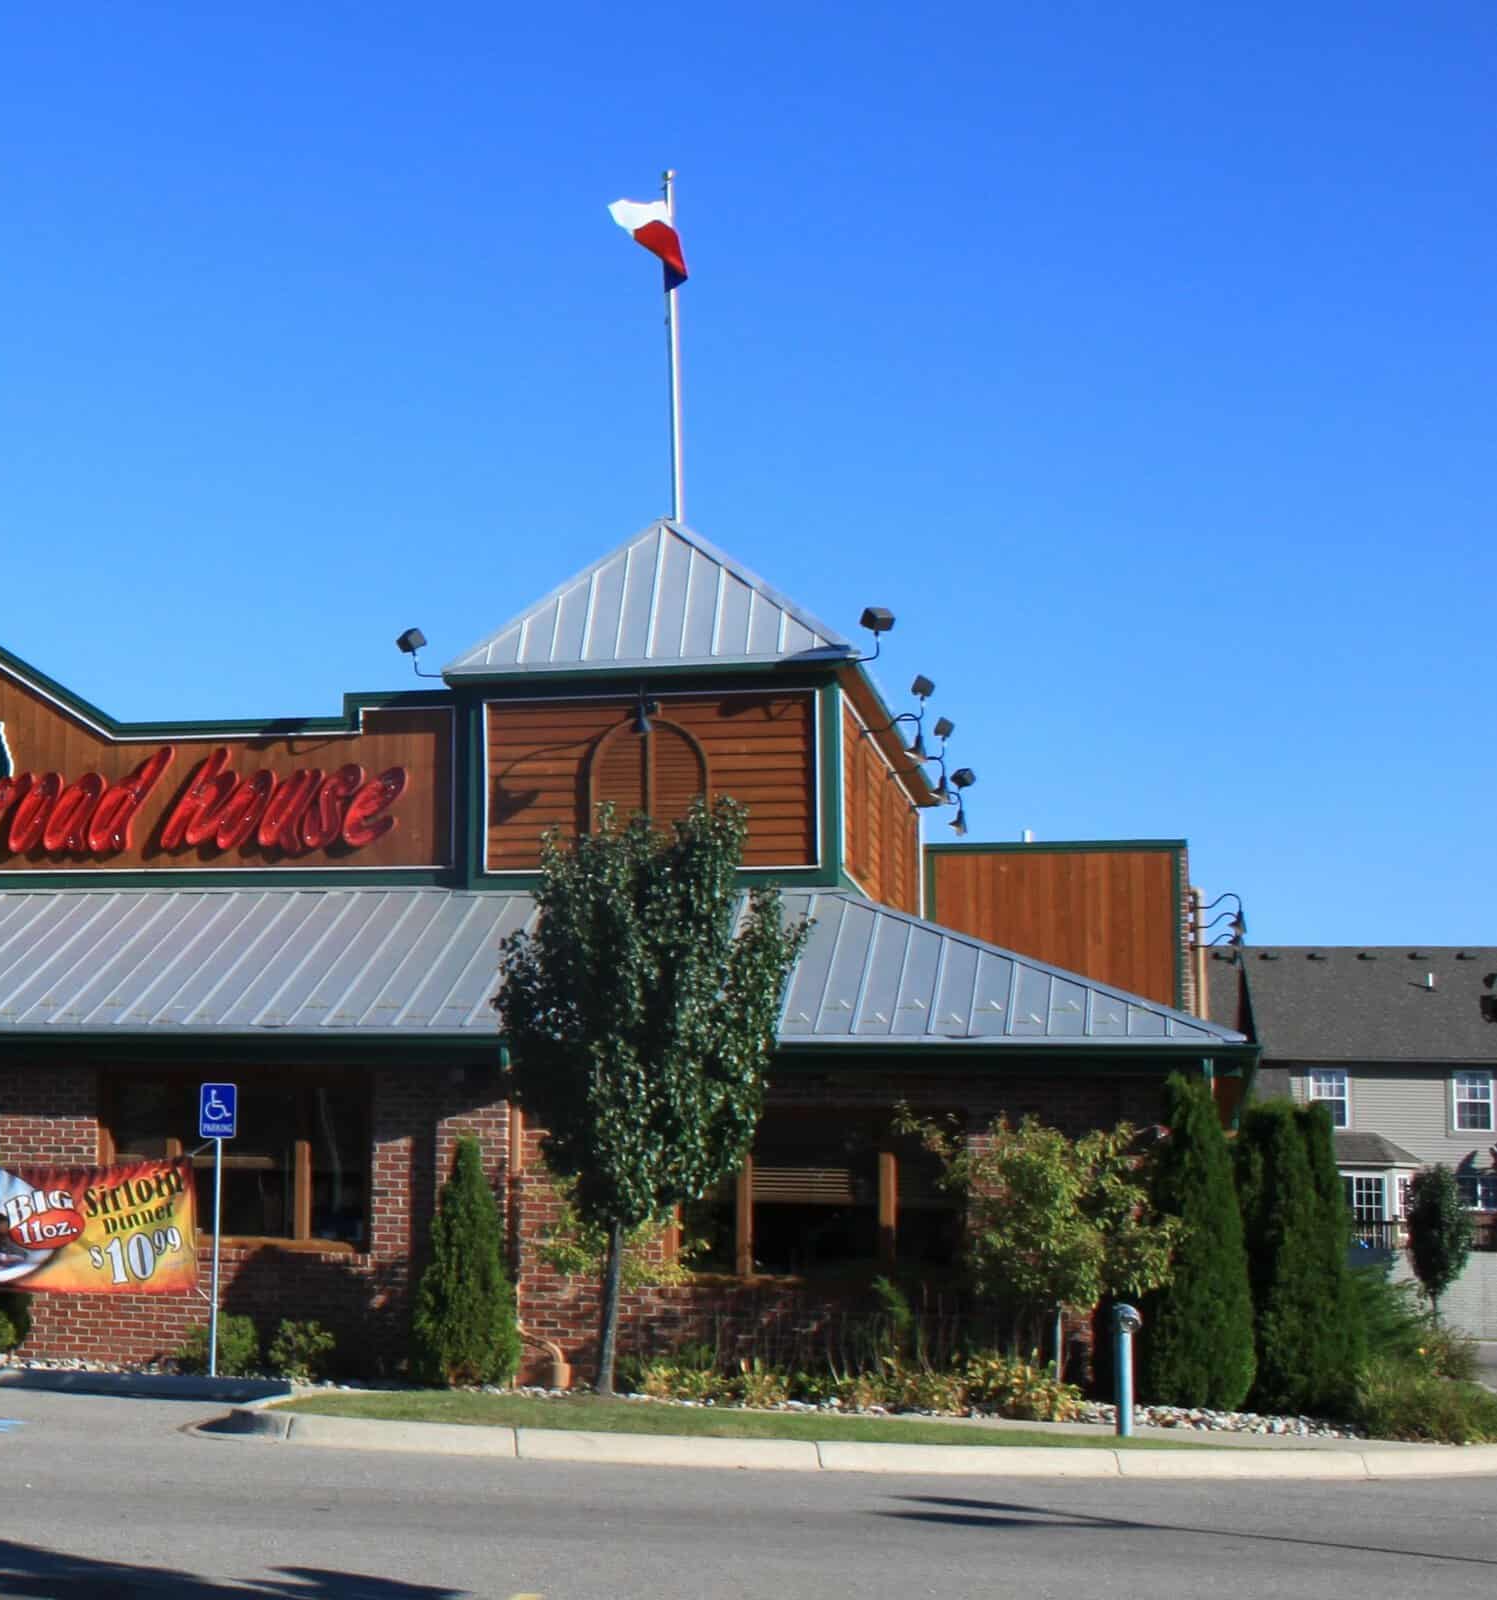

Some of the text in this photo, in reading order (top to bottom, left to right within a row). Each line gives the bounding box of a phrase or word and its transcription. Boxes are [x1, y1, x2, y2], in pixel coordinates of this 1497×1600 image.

[160, 746, 408, 854] house
[5, 1190, 74, 1229] BIG
[102, 1202, 175, 1235] Dinner
